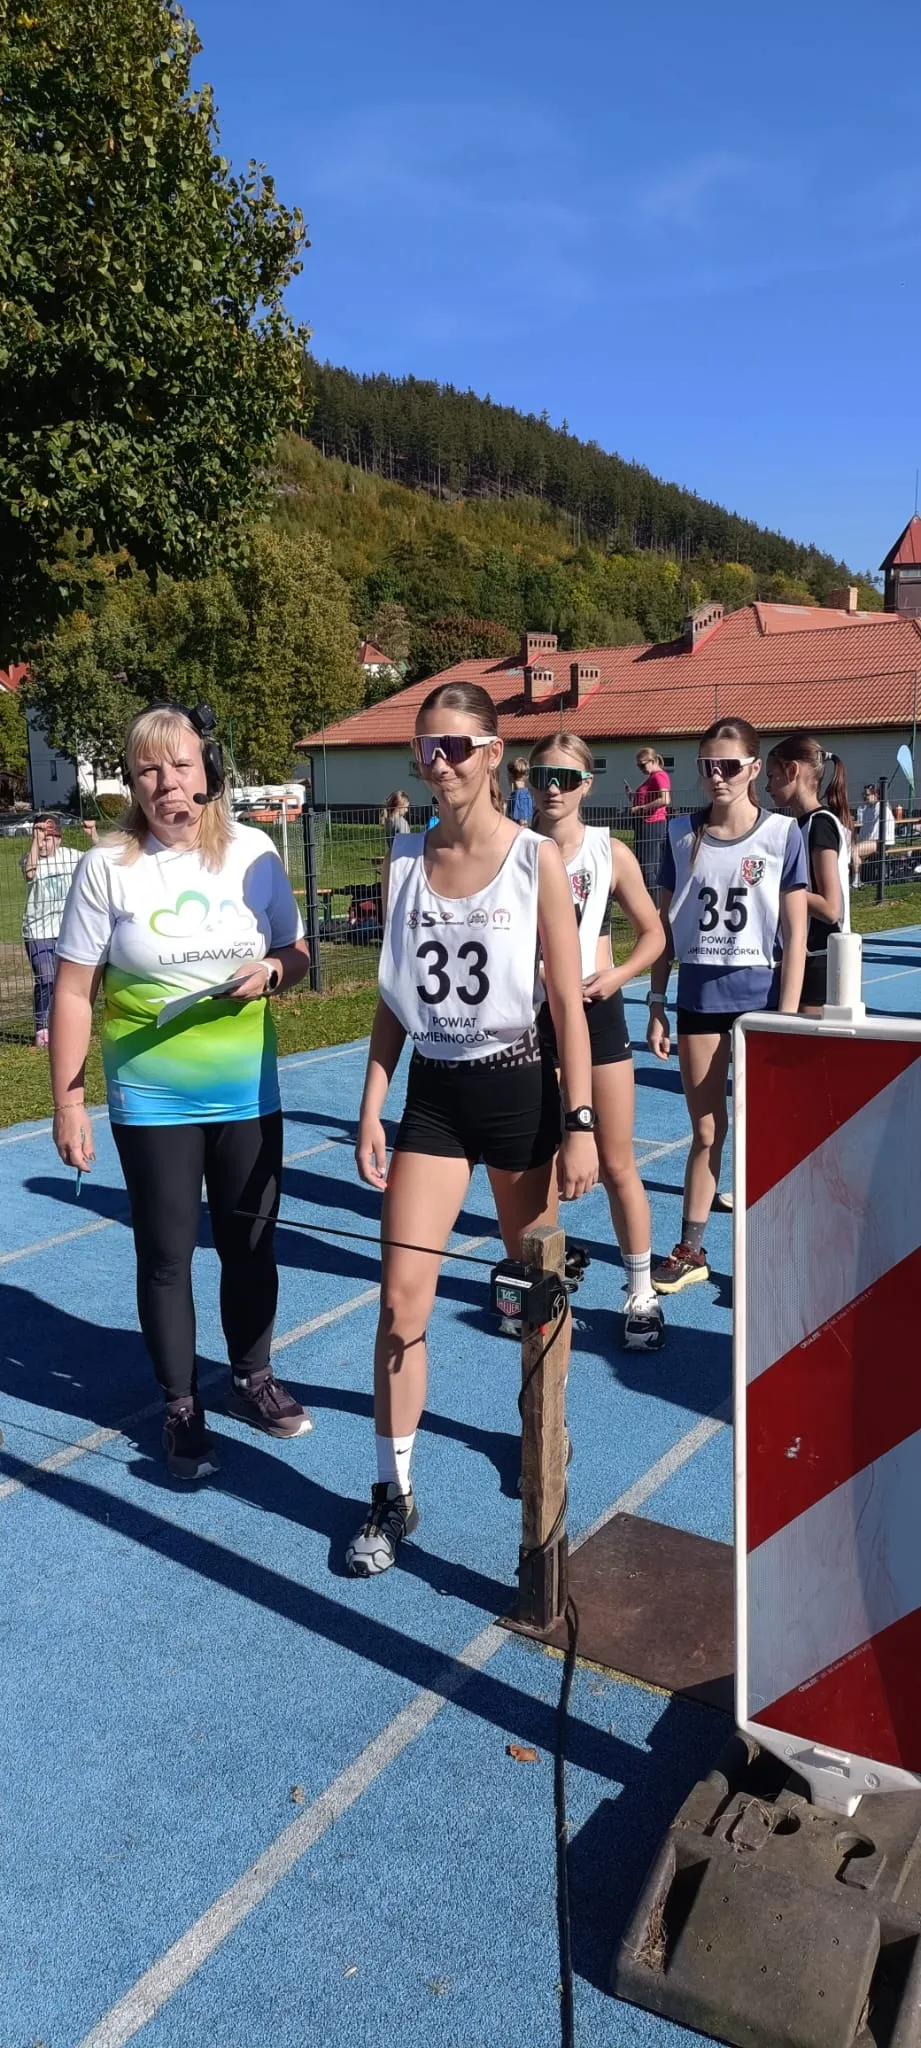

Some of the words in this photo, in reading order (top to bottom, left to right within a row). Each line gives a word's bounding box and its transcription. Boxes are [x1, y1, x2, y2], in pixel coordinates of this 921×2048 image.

[698, 886, 749, 933] 35
[701, 935, 737, 945] POWIAT
[158, 947, 254, 966] LUBAWKA
[687, 946, 760, 956] AMIENNOGÓRSKI
[416, 940, 490, 1005] 33
[432, 1016, 477, 1029] POWIAT
[500, 1288, 517, 1302] TAG
[498, 1301, 520, 1314] HEUER
